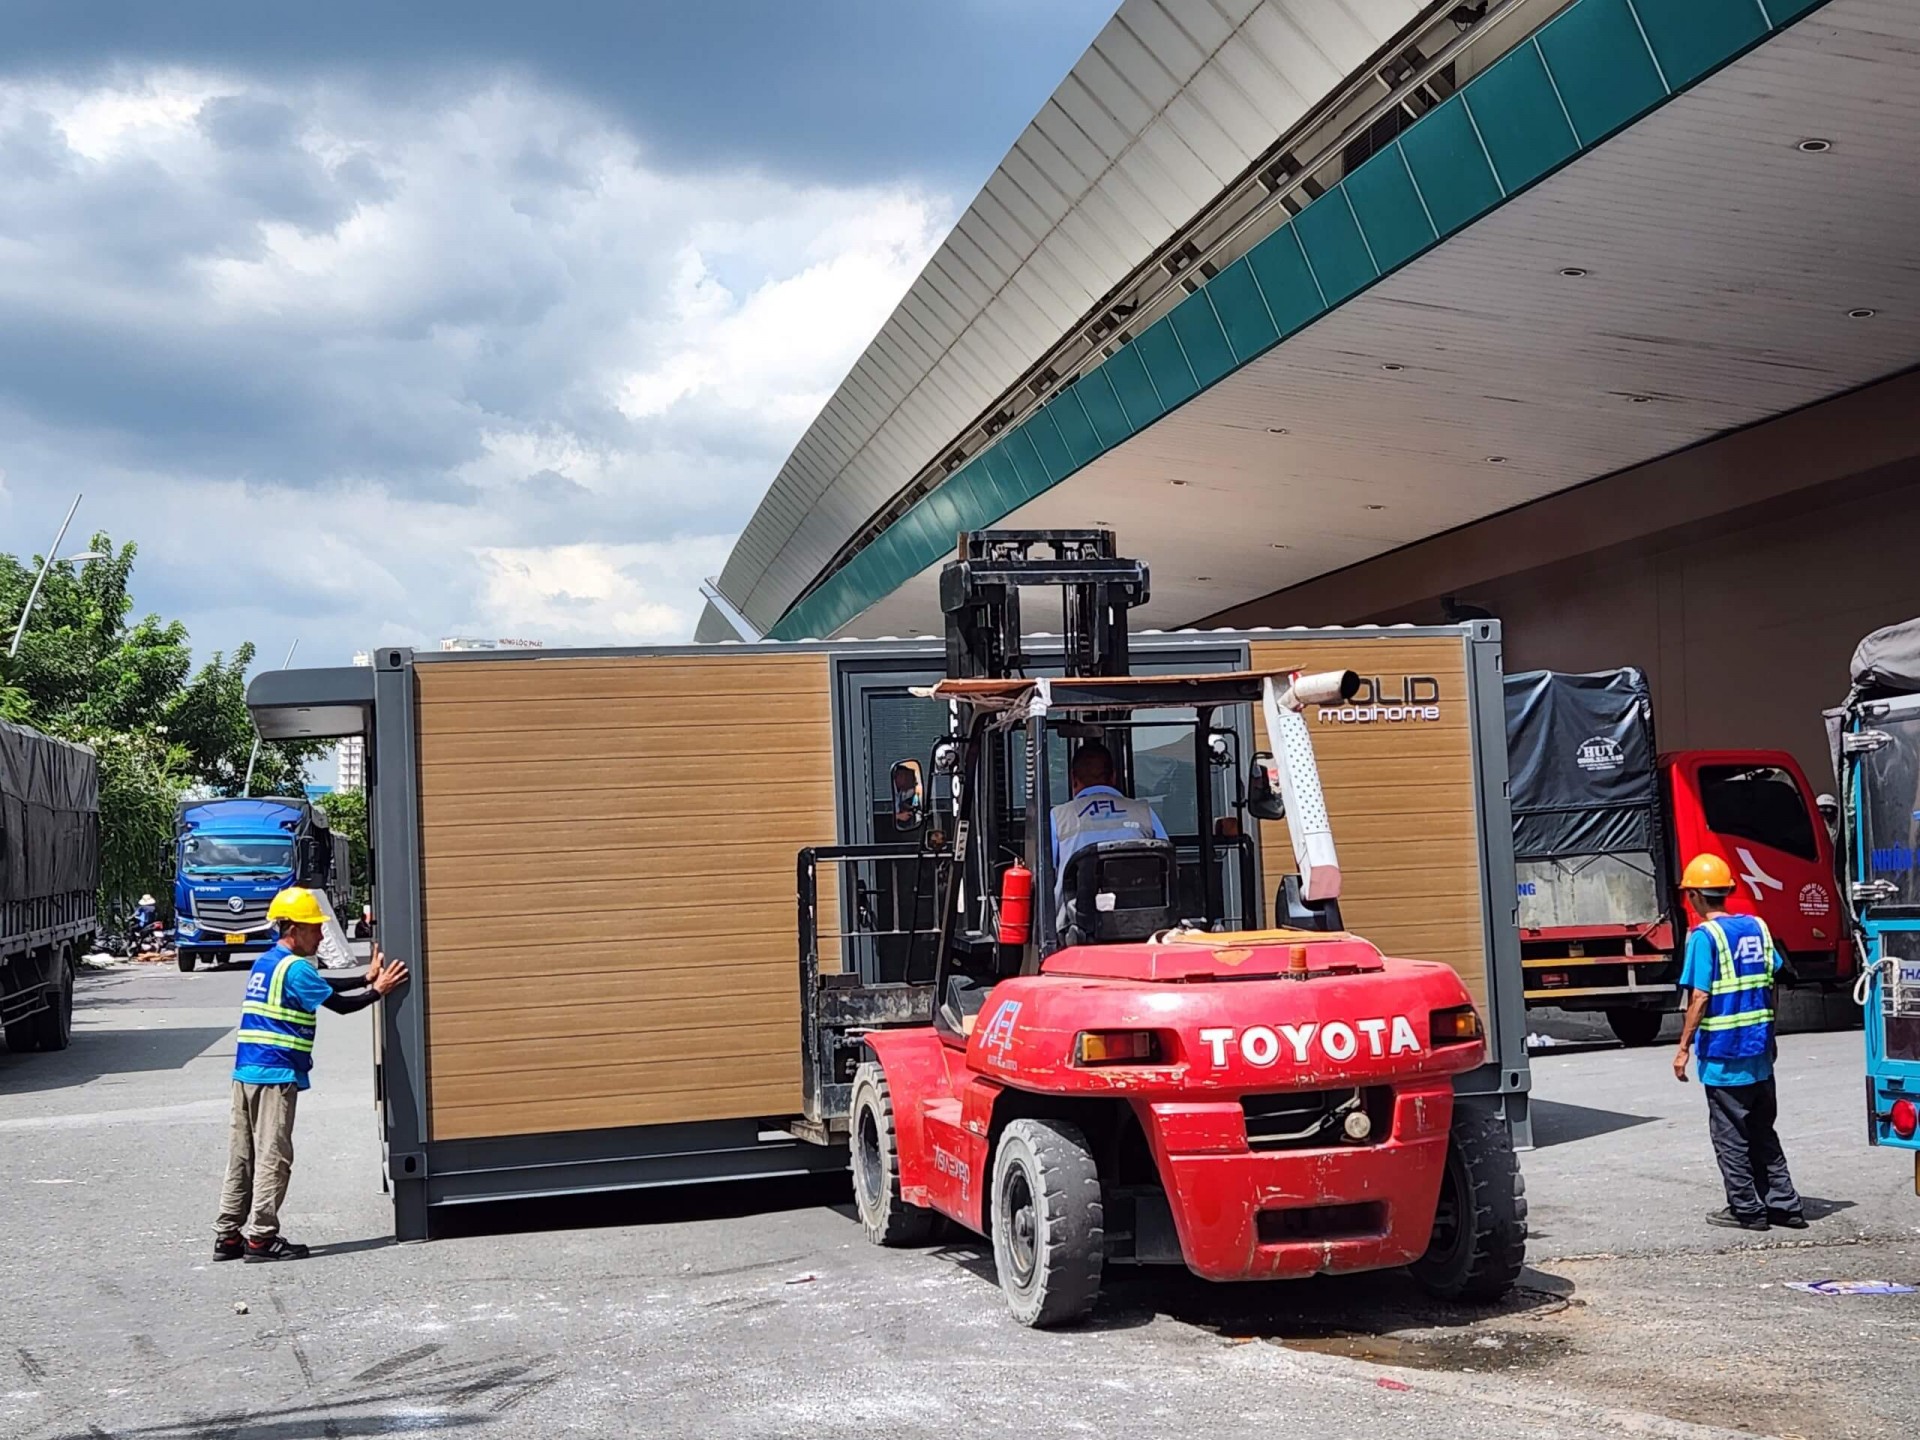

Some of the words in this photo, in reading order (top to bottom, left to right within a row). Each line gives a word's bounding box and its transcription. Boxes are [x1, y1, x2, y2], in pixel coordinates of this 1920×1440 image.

[1320, 676, 1440, 706] OLID
[1318, 705, 1440, 723] mobihome
[1583, 744, 1615, 758] HUY
[1078, 799, 1127, 817] AFL
[1200, 1015, 1421, 1067] TOYOTA
